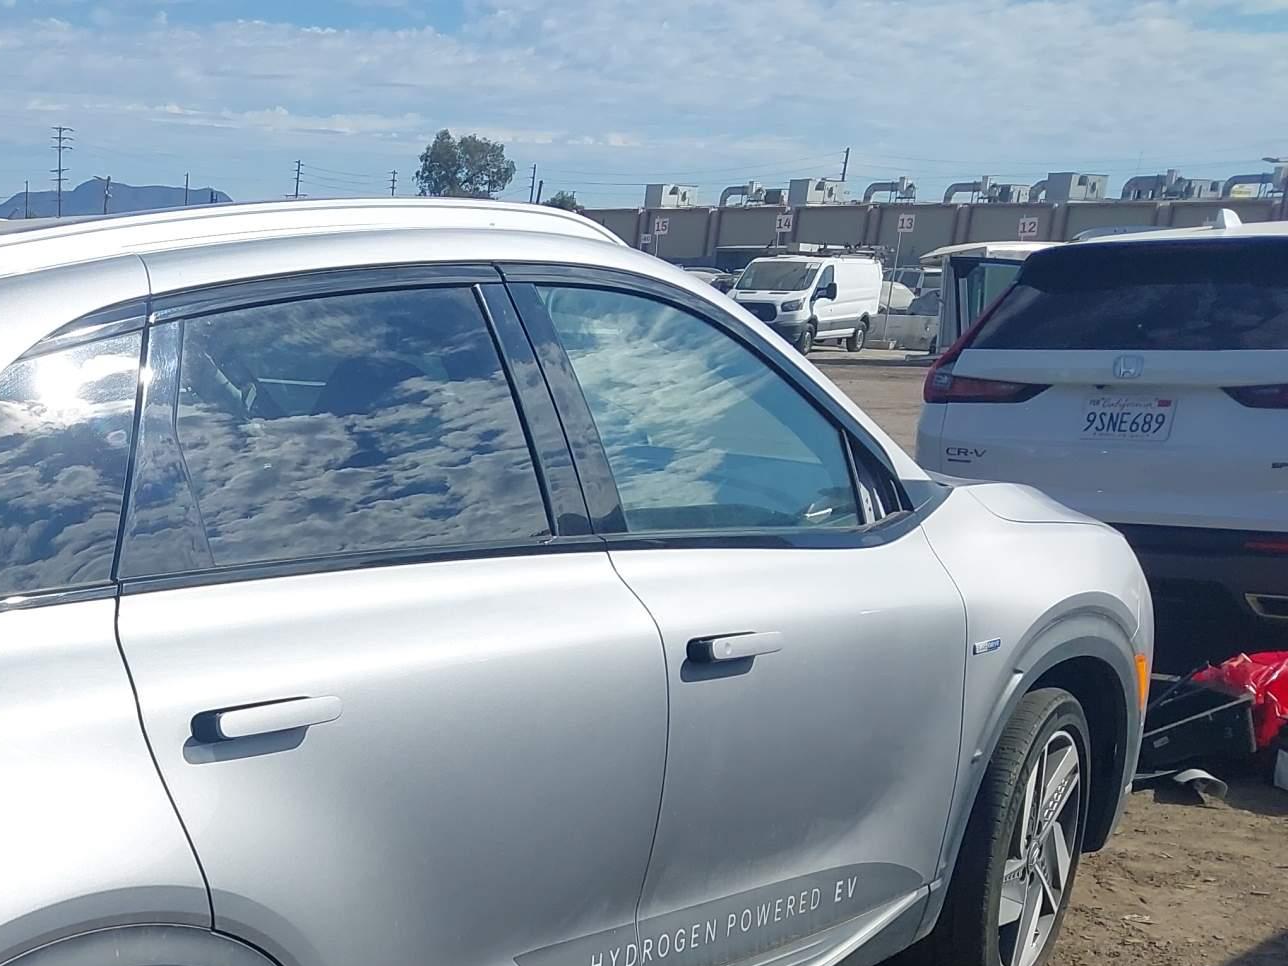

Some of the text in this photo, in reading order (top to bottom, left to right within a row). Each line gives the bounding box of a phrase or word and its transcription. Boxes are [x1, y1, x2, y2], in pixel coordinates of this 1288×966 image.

[655, 220, 668, 233] 15
[777, 218, 792, 230] 14
[898, 217, 913, 230] 13
[1019, 221, 1037, 234] 12
[1083, 411, 1166, 434] 9SNE689
[945, 447, 987, 458] CR-V
[726, 887, 821, 938] POWERED
[833, 876, 858, 903] EV
